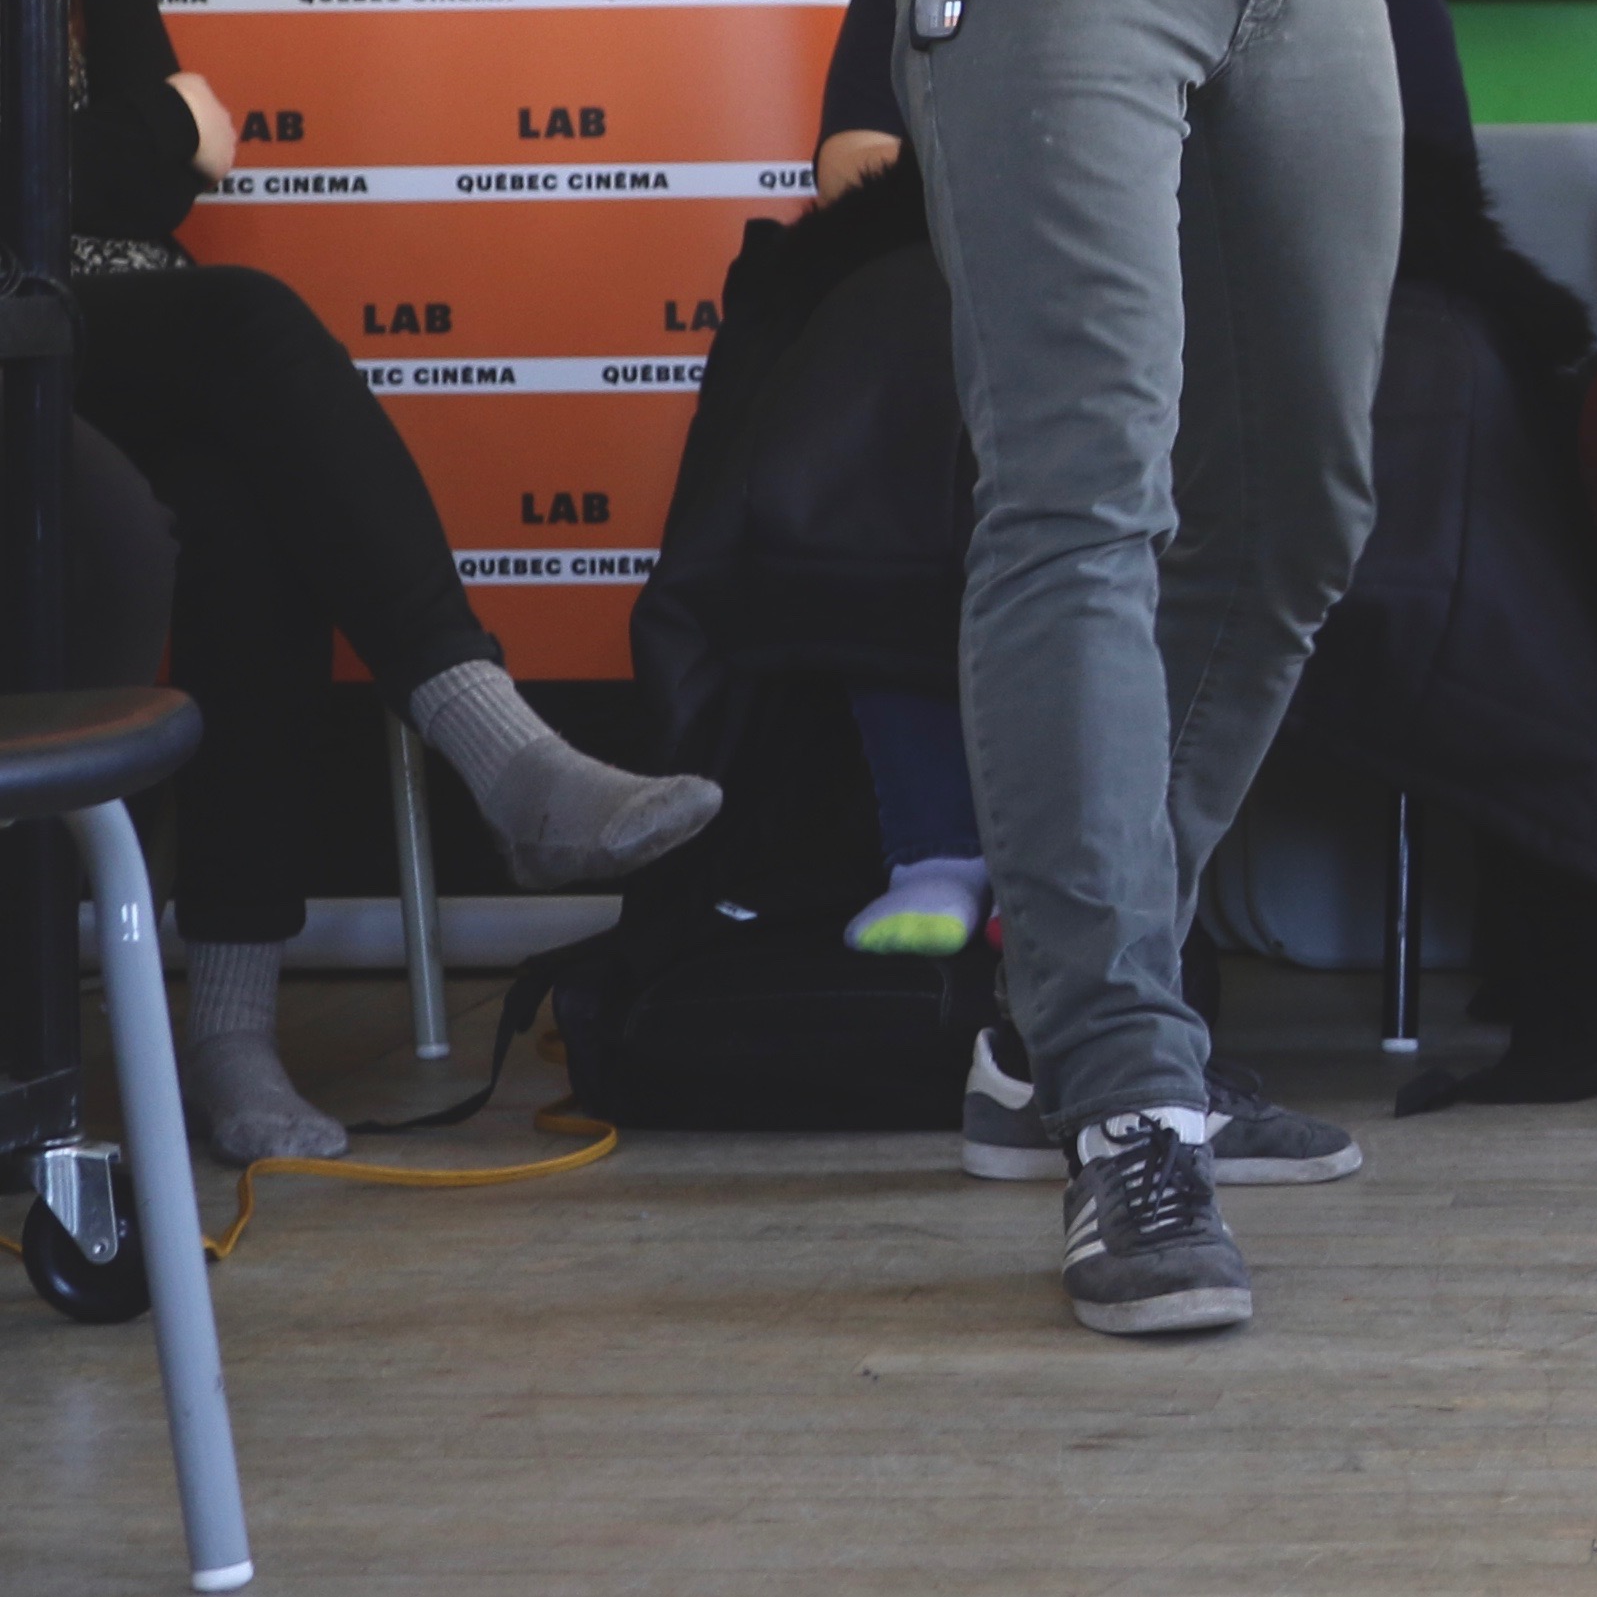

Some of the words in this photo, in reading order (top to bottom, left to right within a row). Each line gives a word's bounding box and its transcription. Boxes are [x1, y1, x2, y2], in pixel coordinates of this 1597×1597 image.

[241, 111, 305, 143] AB
[518, 107, 606, 140] LAB
[264, 175, 368, 195] CINÉMA
[456, 172, 557, 194] QUÉBEC
[567, 171, 669, 190] CINÉMA
[758, 169, 812, 190] QUÉ
[363, 303, 452, 335] LAB
[665, 300, 722, 332] LA
[413, 366, 516, 385] CINÉMA
[603, 364, 705, 384] QUÉBEC
[521, 492, 610, 525] LAB
[459, 556, 563, 577] QUÉBEC
[570, 554, 658, 575] CINÉM
